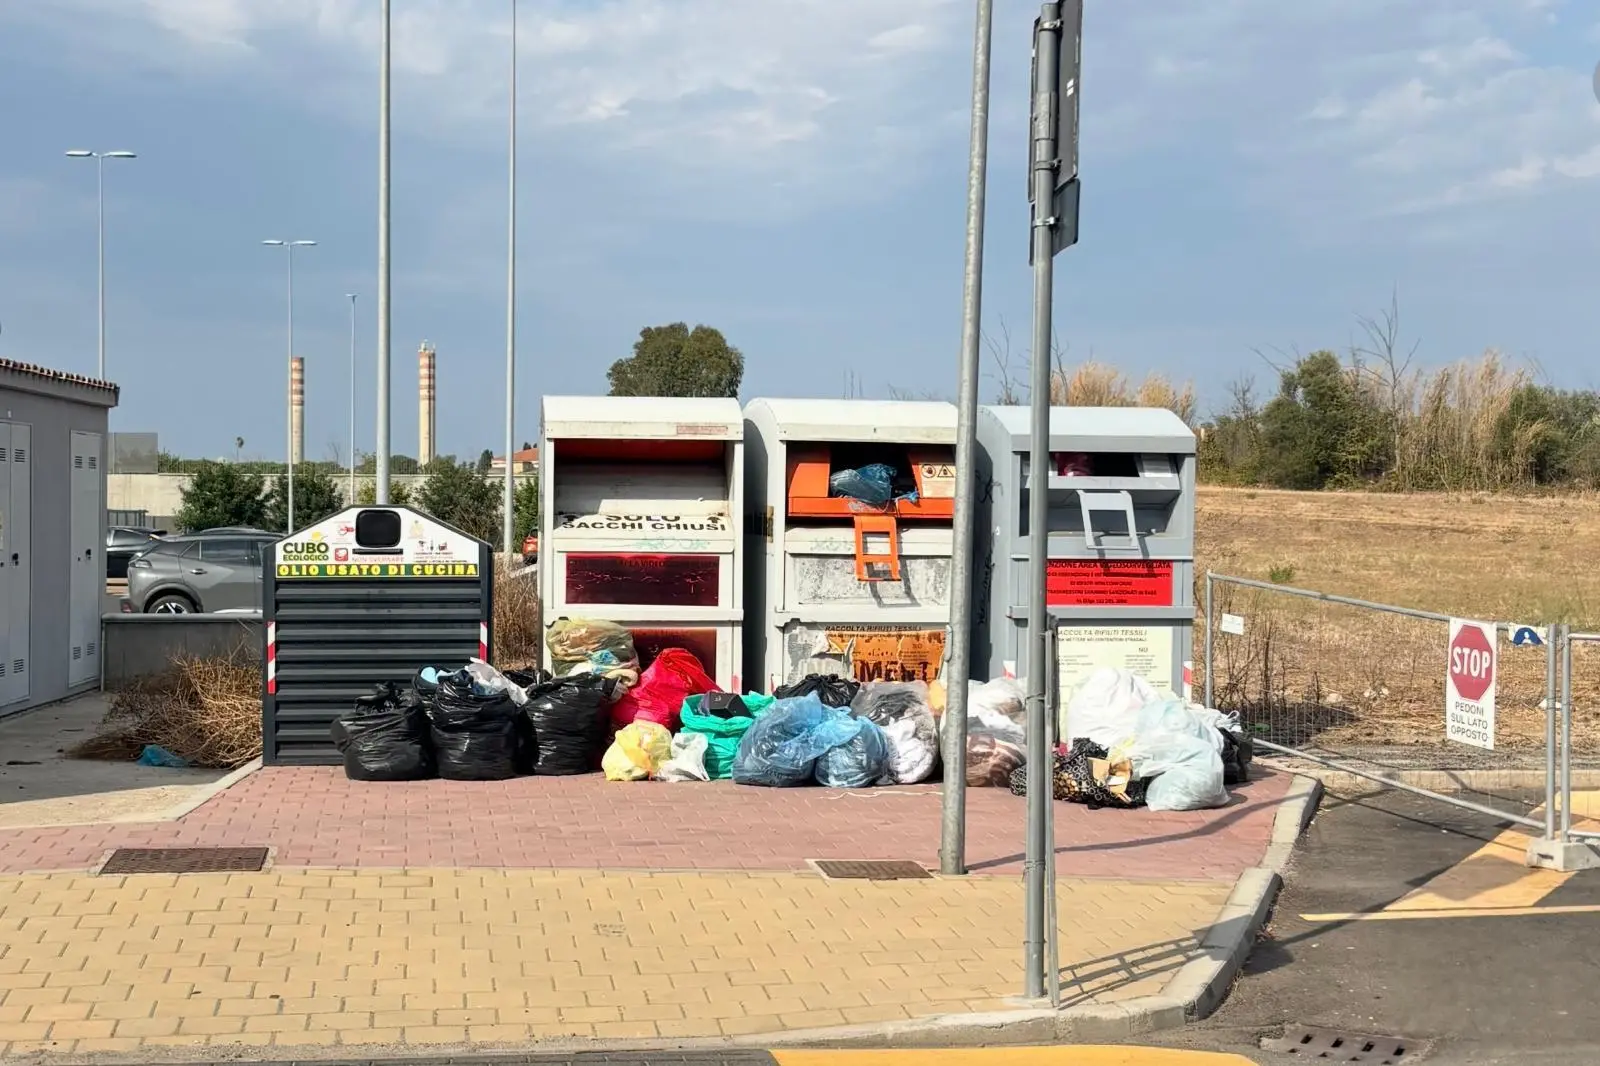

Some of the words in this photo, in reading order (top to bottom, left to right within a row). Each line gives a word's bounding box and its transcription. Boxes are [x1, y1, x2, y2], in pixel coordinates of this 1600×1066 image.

[562, 521, 643, 530] SACCHI
[652, 522, 726, 531] CHIUSI
[283, 542, 329, 554] CUBO
[283, 554, 329, 562] ECOLOGICO
[279, 564, 320, 576] OLIO
[327, 564, 383, 576] USATO
[388, 564, 405, 576] DI
[413, 564, 478, 576] CUCINA
[1047, 561, 1077, 569] NZIONE
[1078, 561, 1098, 569] AREA
[1452, 646, 1491, 679] STOP
[1455, 701, 1485, 716] PEDONI
[1450, 712, 1467, 726] SUL
[1467, 716, 1489, 730] LATO
[1450, 724, 1489, 742] OPPOSTO
